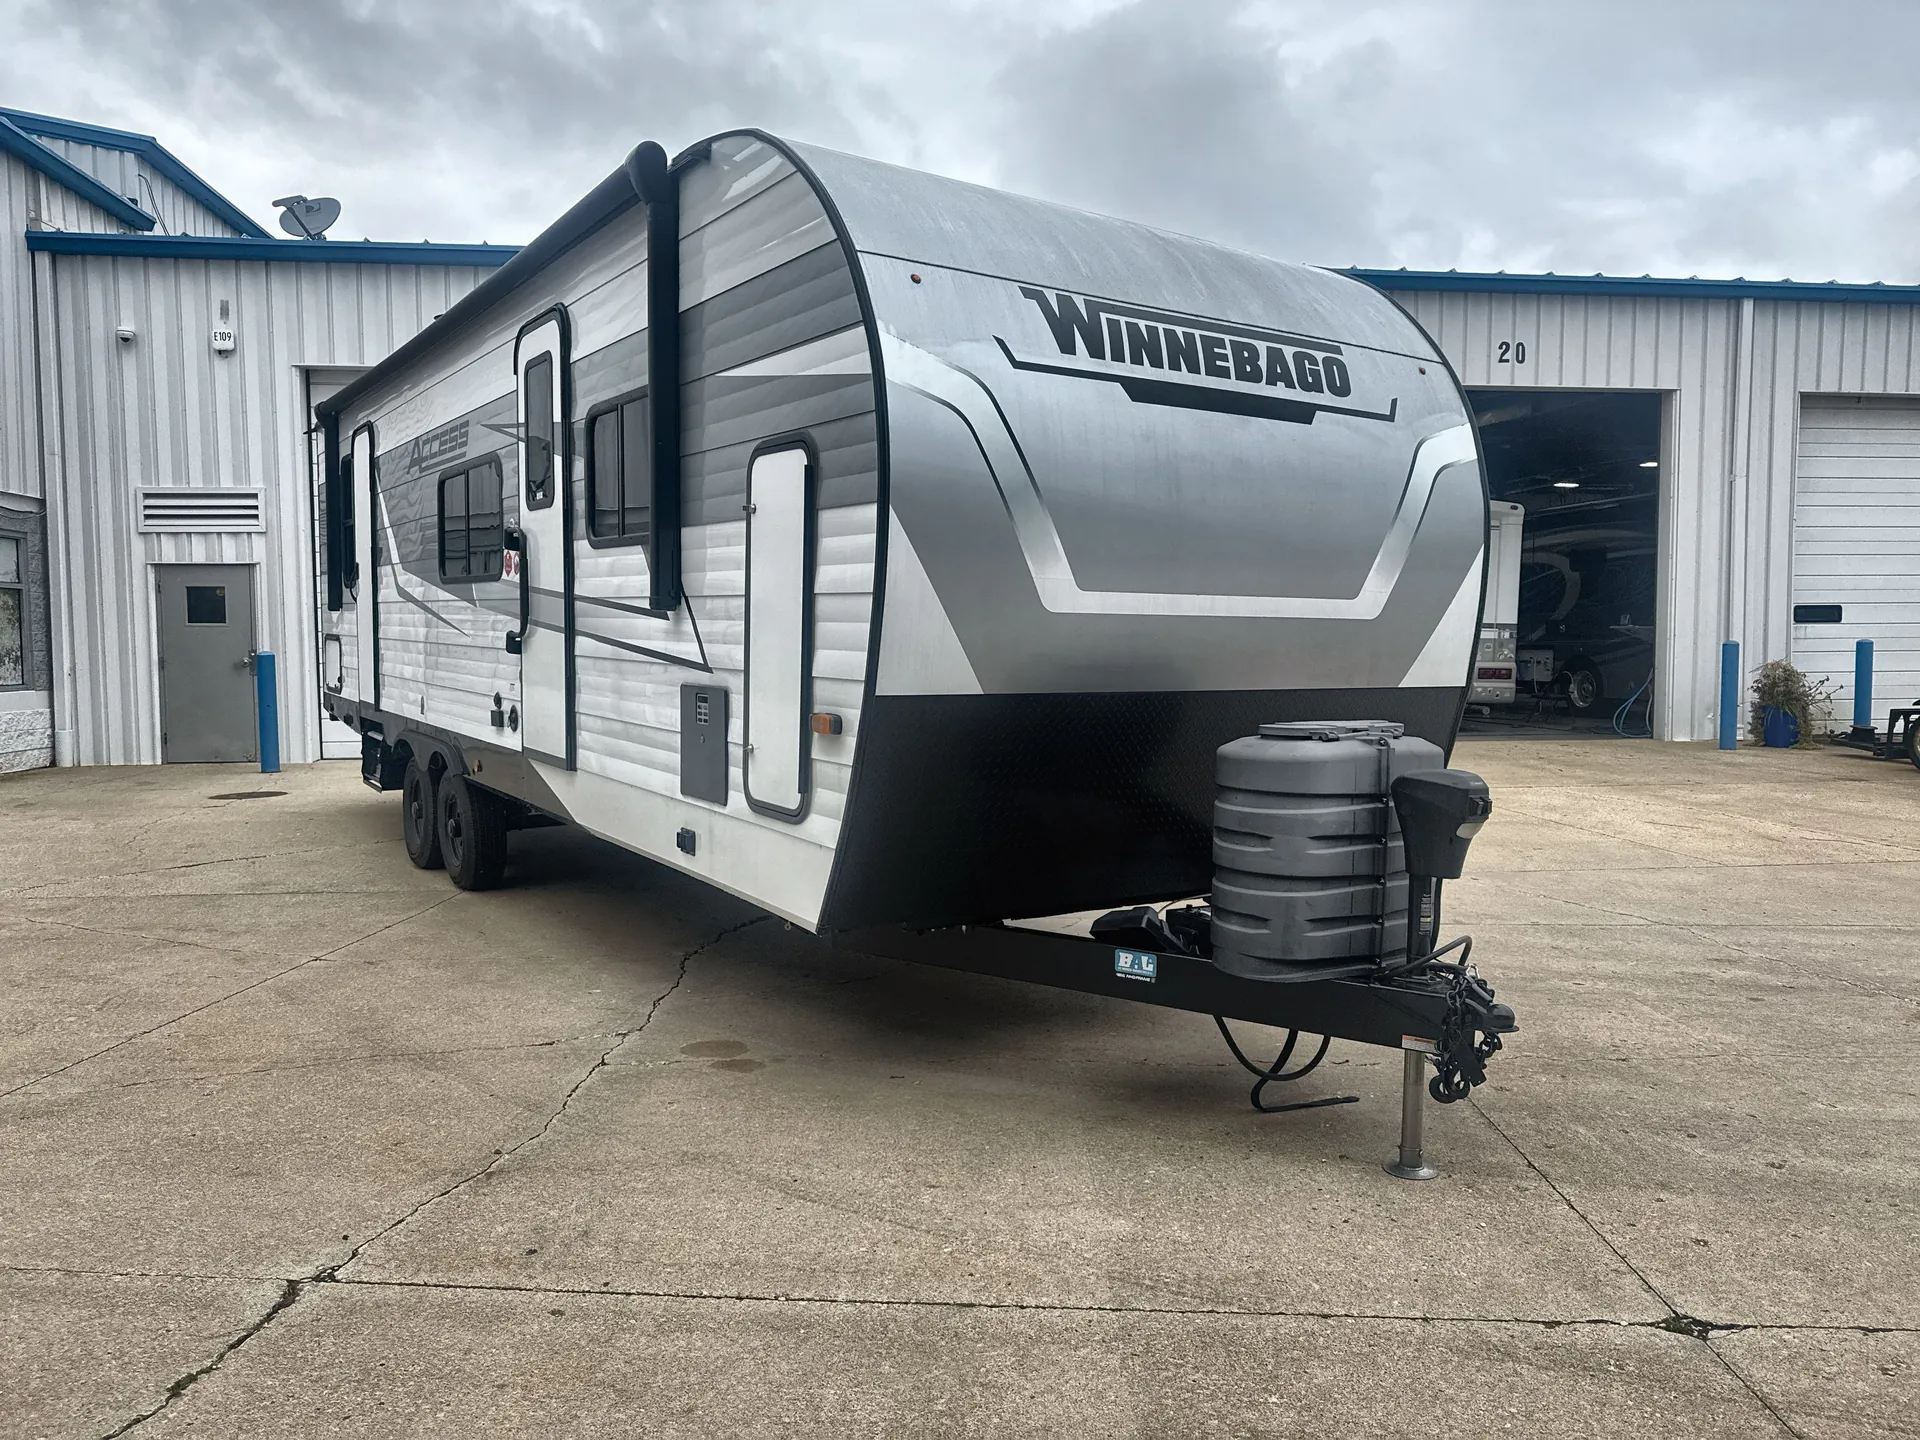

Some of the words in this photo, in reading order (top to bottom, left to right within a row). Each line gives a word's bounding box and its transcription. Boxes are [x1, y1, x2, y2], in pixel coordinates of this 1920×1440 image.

[213, 331, 232, 341] E109
[1018, 286, 1352, 399] WINNEBAGO
[1498, 341, 1526, 364] 20
[406, 419, 470, 475] ACCESS
[1118, 952, 1154, 972] BAL
